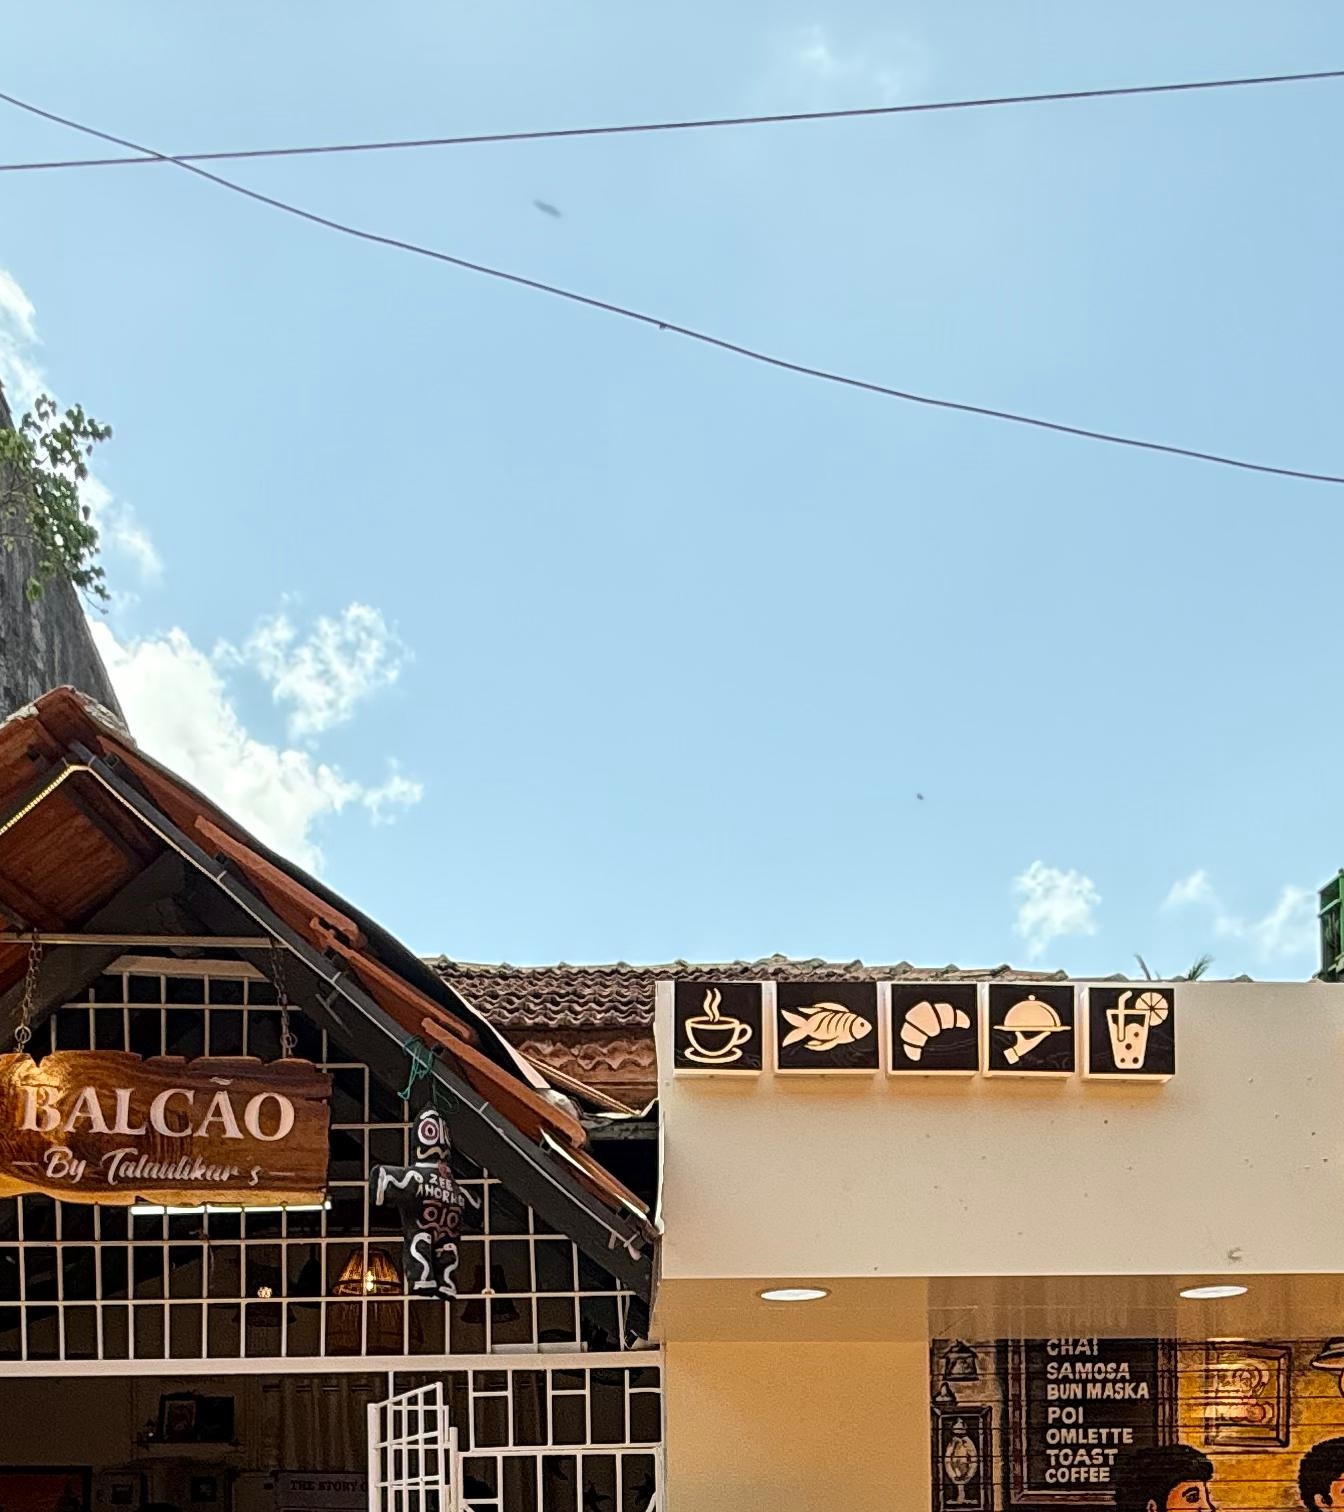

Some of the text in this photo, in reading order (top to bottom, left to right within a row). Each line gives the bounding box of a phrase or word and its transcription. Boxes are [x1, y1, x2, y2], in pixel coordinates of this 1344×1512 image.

[19, 1076, 295, 1142] BALCÃO
[43, 1146, 87, 1184] By
[1047, 1338, 1098, 1356] CHAI
[1047, 1362, 1130, 1380] SAMOSA
[1047, 1382, 1149, 1400] BUN MASKA
[1047, 1407, 1083, 1424] POI
[1046, 1428, 1133, 1445] OMLETTE
[1046, 1448, 1118, 1466] TOAST
[1045, 1468, 1110, 1483] COFFEE
